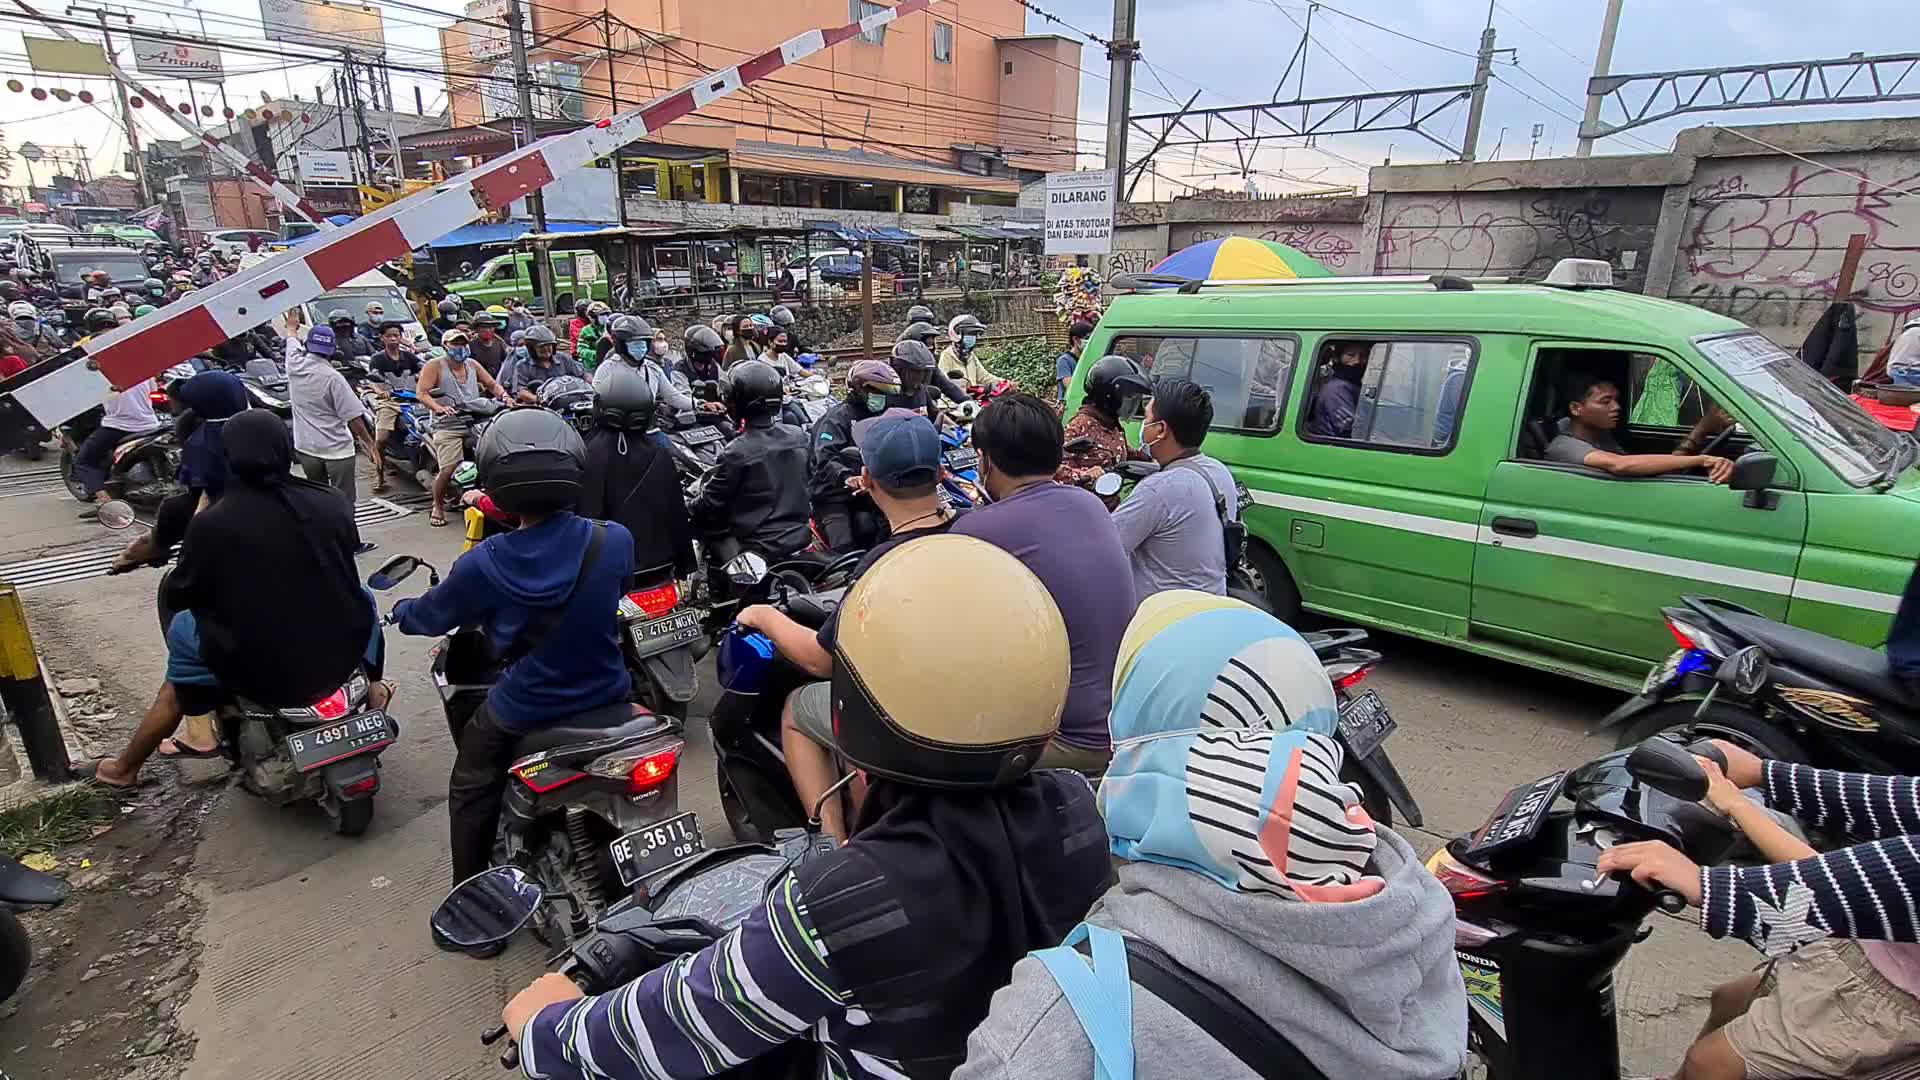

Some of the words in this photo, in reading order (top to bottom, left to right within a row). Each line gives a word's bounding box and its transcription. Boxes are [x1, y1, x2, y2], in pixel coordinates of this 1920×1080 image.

[137, 51, 220, 71] Ananda
[1051, 190, 1107, 204] DILARANG
[1046, 220, 1054, 229] DI
[1055, 219, 1074, 229] ATAS
[1076, 218, 1111, 228] TROTOAR
[1047, 230, 1062, 239] DAN
[1063, 230, 1084, 239] BAHU
[1085, 229, 1110, 239] JALAN
[635, 629, 644, 640] B
[649, 620, 674, 636] 4762
[674, 613, 694, 629] NGK
[293, 738, 304, 753] B
[314, 724, 349, 745] 4897
[355, 714, 382, 733] NEG
[519, 761, 549, 778] VARIO
[633, 789, 660, 801] HONDA
[613, 839, 633, 864] BE
[643, 820, 686, 850] 3611
